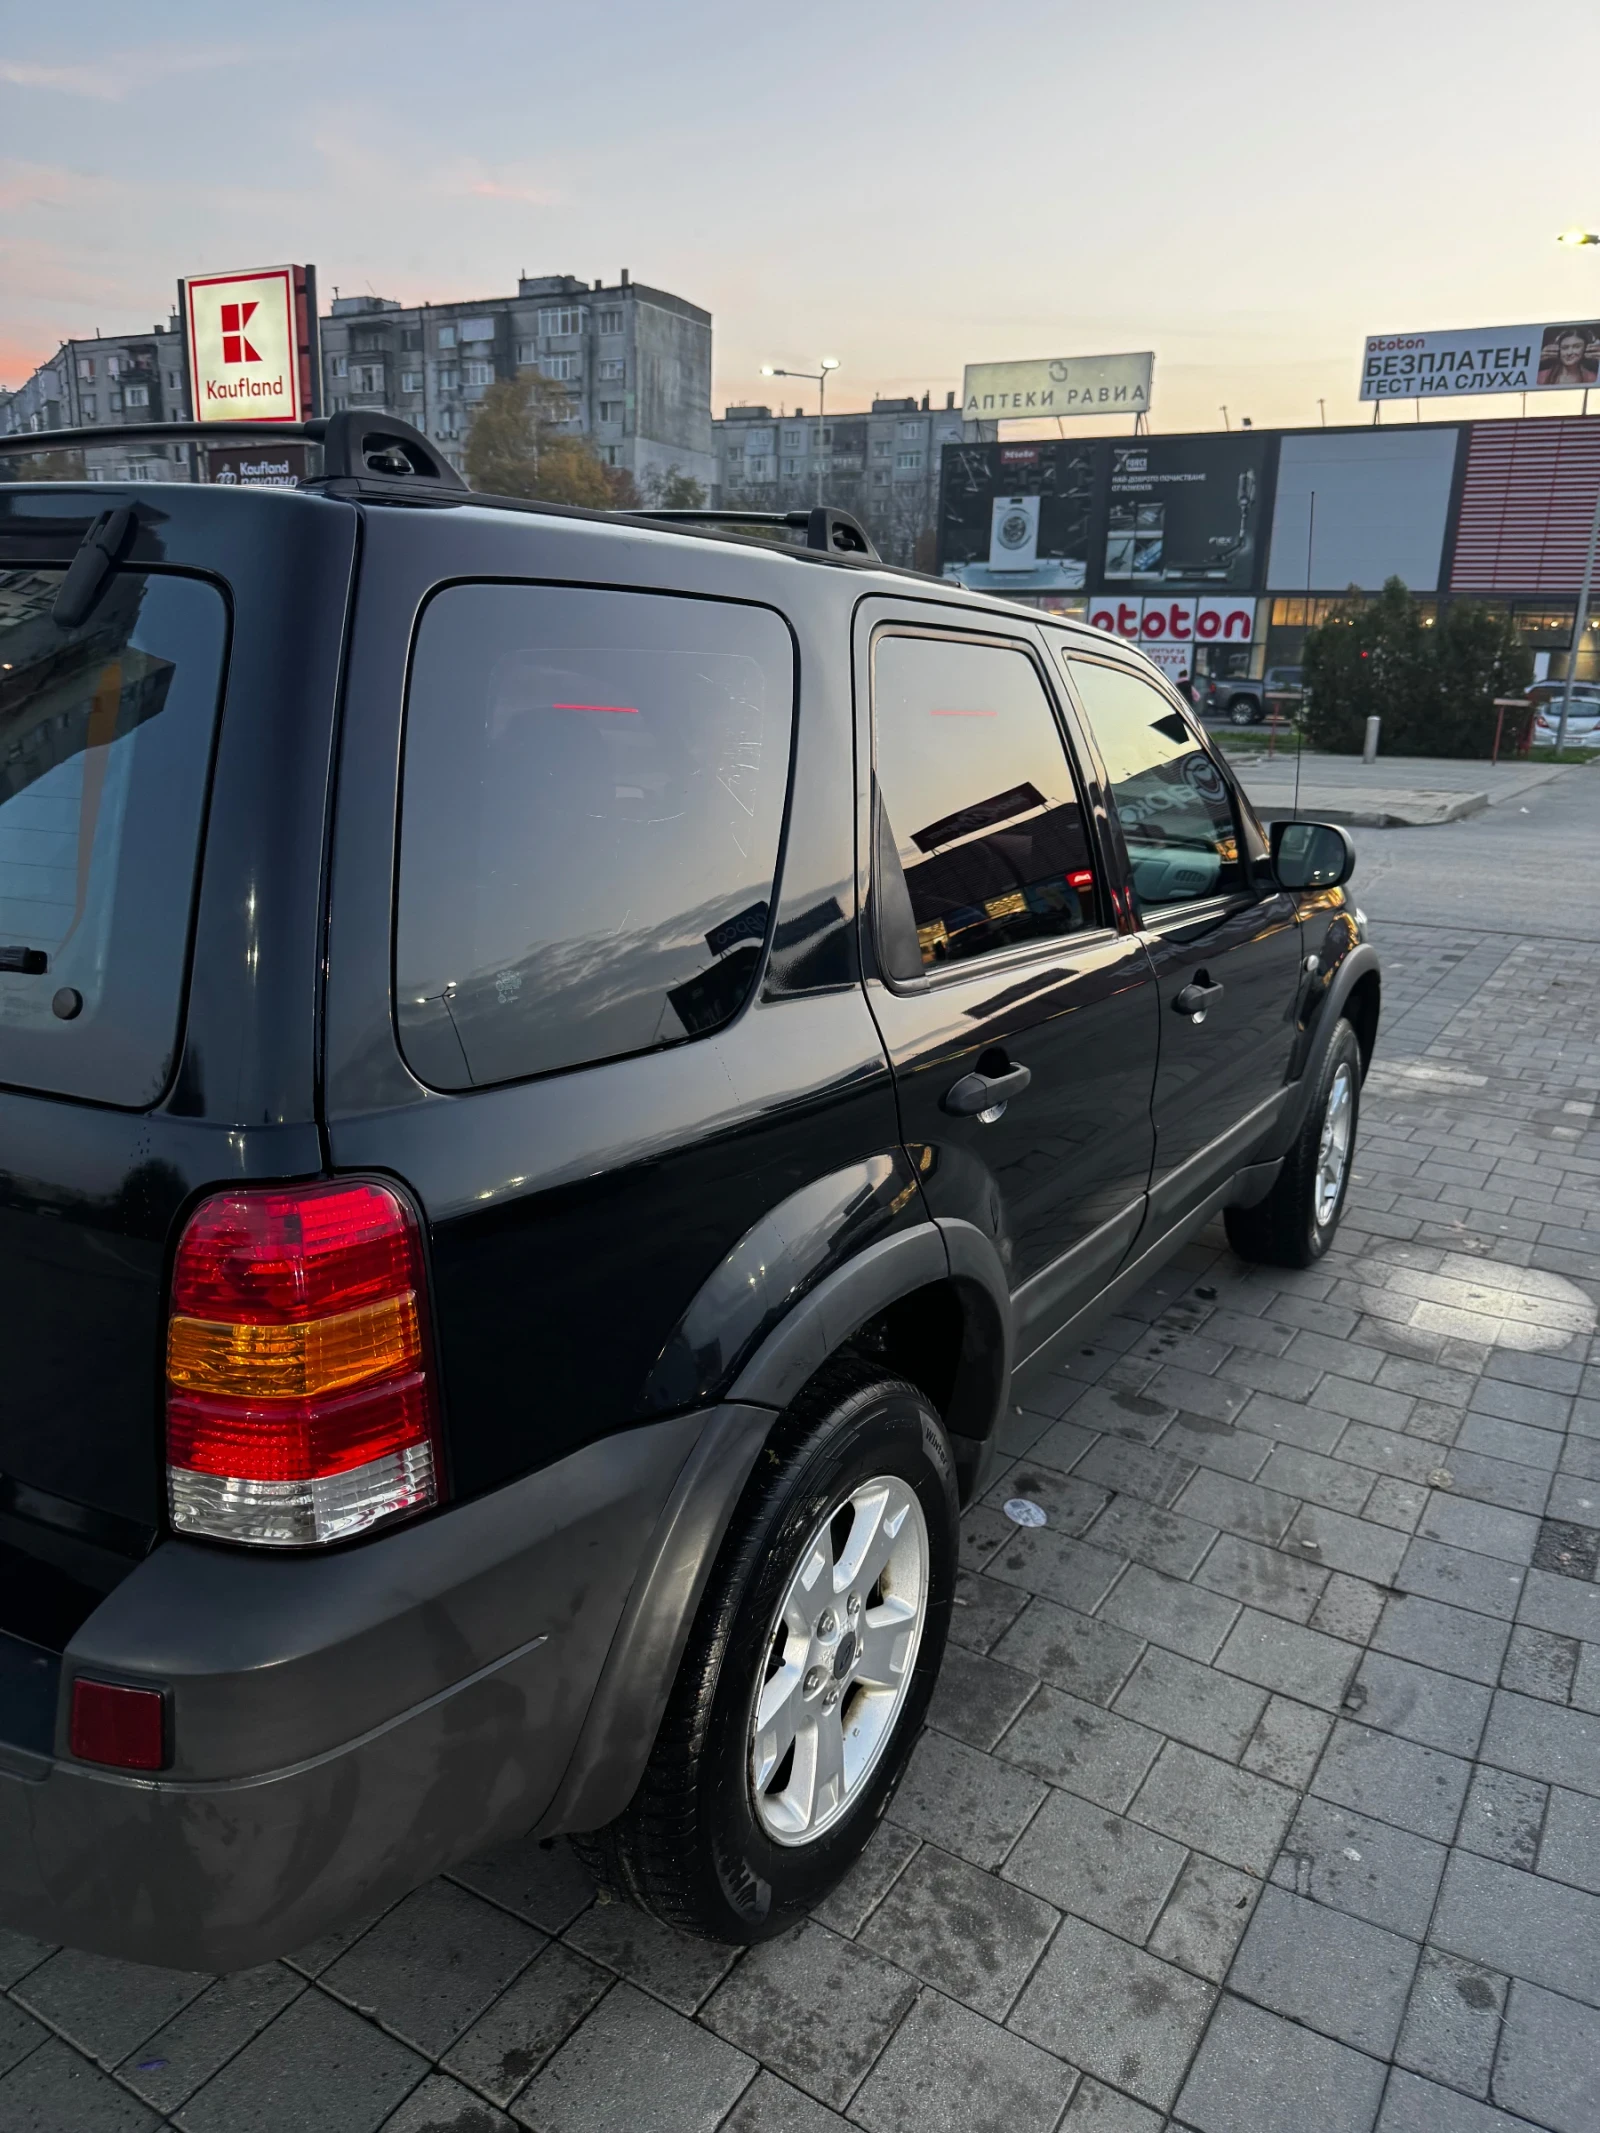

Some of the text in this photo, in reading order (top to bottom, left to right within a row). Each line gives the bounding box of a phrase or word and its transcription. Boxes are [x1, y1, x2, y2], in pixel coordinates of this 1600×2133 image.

[1367, 337, 1426, 353] ototon
[1366, 346, 1532, 378] БЕЗПЛАТЕН
[206, 375, 284, 400] Kaufland
[1364, 370, 1529, 395] ТЕСТ НА СЛУХА
[967, 384, 1146, 411] АПТЕКИ РАВИА
[239, 460, 290, 476] Kaufland
[1091, 603, 1251, 639] ototon
